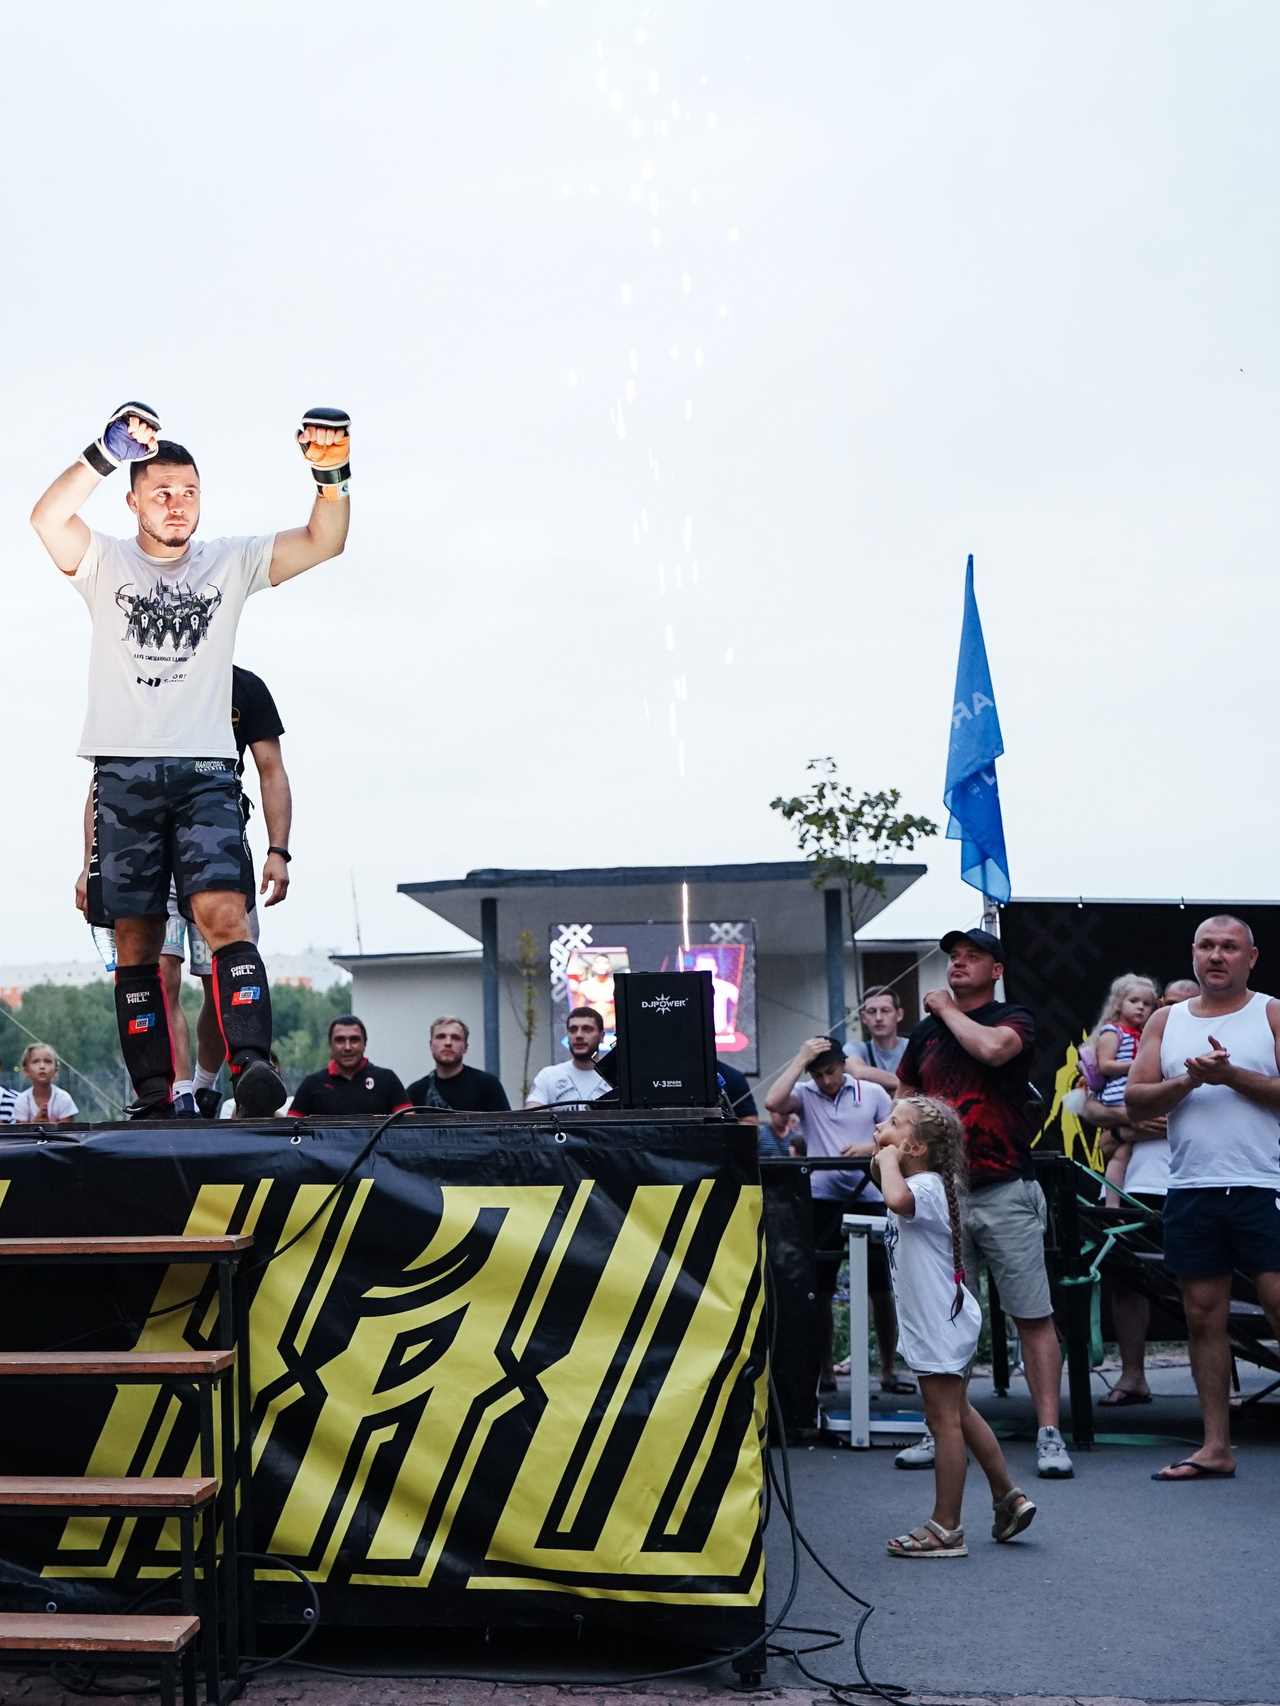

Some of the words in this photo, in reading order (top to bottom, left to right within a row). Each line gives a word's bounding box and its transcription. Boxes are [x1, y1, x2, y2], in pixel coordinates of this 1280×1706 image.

[231, 964, 256, 973] GREEN
[231, 969, 253, 978] HILL
[125, 991, 150, 999] GREEN
[652, 1080, 666, 1088] V-3
